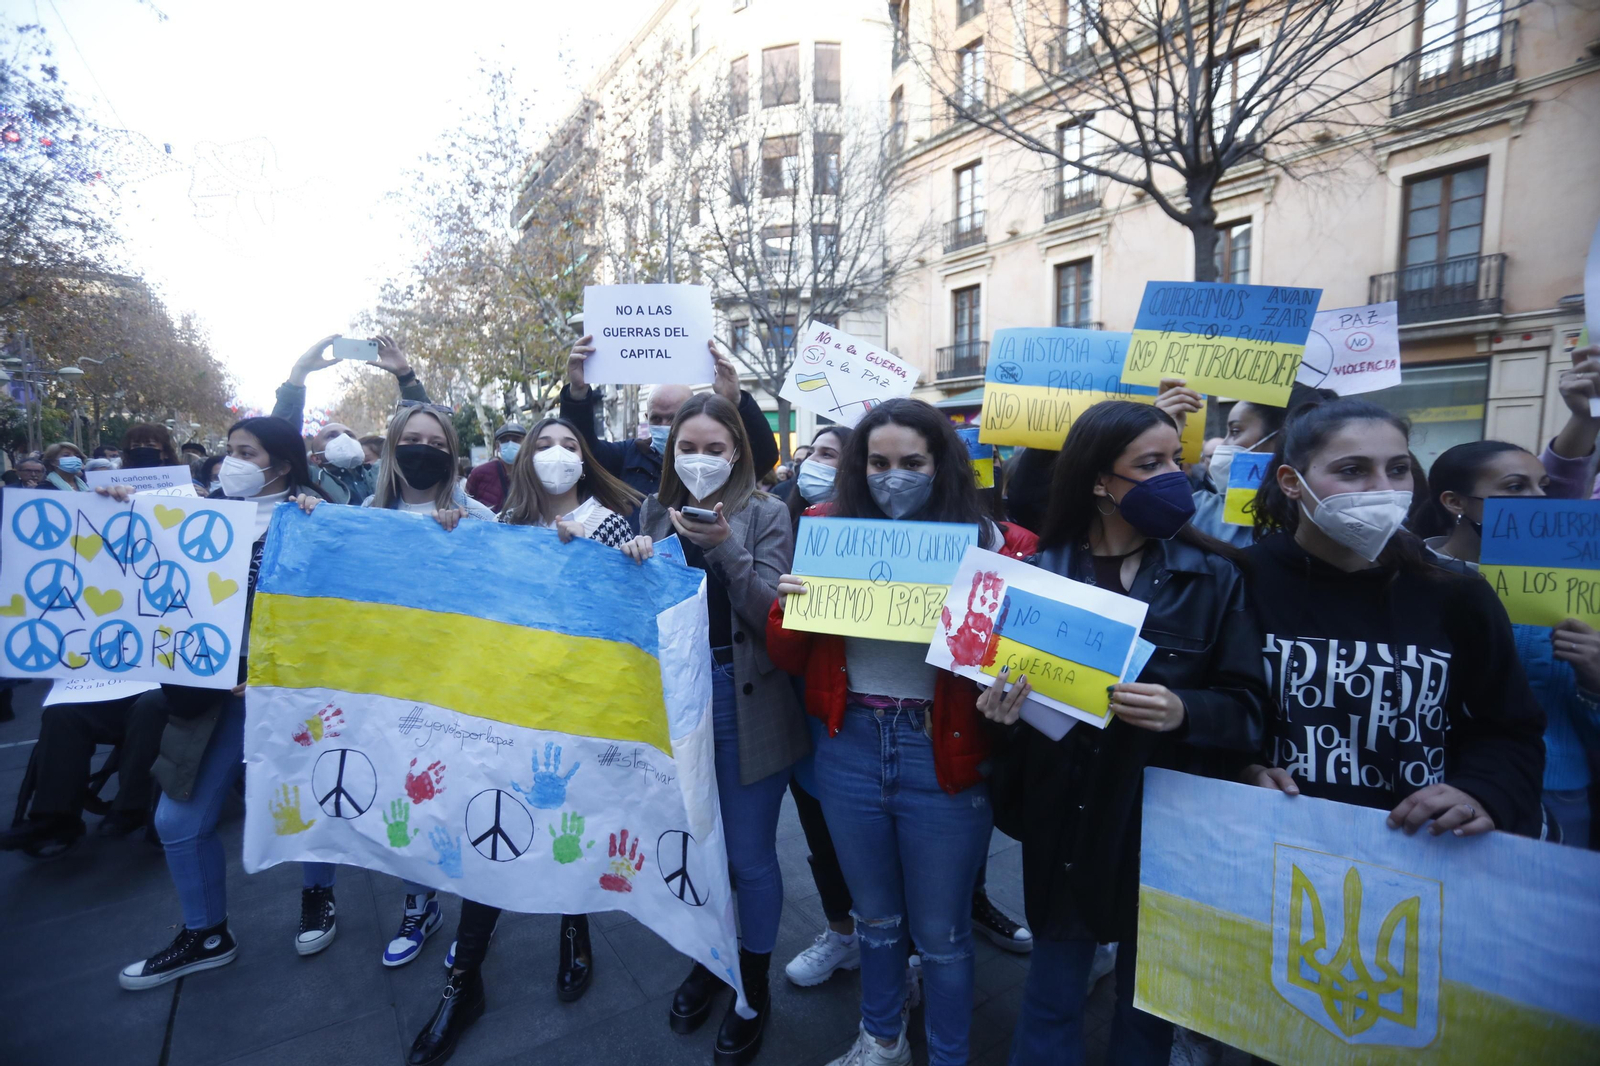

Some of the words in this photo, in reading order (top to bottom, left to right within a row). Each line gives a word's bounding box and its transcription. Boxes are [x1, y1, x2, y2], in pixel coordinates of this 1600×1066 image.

[615, 305, 633, 316] NO
[636, 305, 645, 316] A
[648, 304, 673, 316] LAS
[1149, 286, 1251, 321] QUEREMOS
[1267, 287, 1316, 306] AVAN
[1260, 306, 1308, 328] ZAR
[603, 327, 661, 338] GUERRAS
[664, 327, 689, 338] DEL
[1338, 310, 1378, 328] PAZ
[1235, 324, 1282, 347] PUTIN
[1349, 338, 1368, 350] NO
[620, 348, 672, 359] CAPITAL
[997, 336, 1016, 361] LA
[1102, 339, 1121, 365] SE
[1128, 339, 1158, 372] NO
[1161, 341, 1303, 388] RETROCEDER
[861, 368, 891, 388] PAZ
[1333, 359, 1398, 376] VIOLENCIA
[1047, 369, 1094, 397] PARA
[985, 391, 1021, 431] NO
[1491, 508, 1519, 539] LA
[72, 499, 161, 580] NO
[804, 525, 830, 558] NO
[835, 525, 912, 558] QUEREMOS
[1522, 571, 1558, 595] LOS
[38, 585, 86, 621] A
[137, 587, 194, 619] LA
[887, 584, 948, 629] PAZ
[1013, 605, 1041, 628] NO
[1056, 620, 1069, 638] A
[1084, 628, 1105, 652] LA
[1006, 653, 1076, 685] GUERRA
